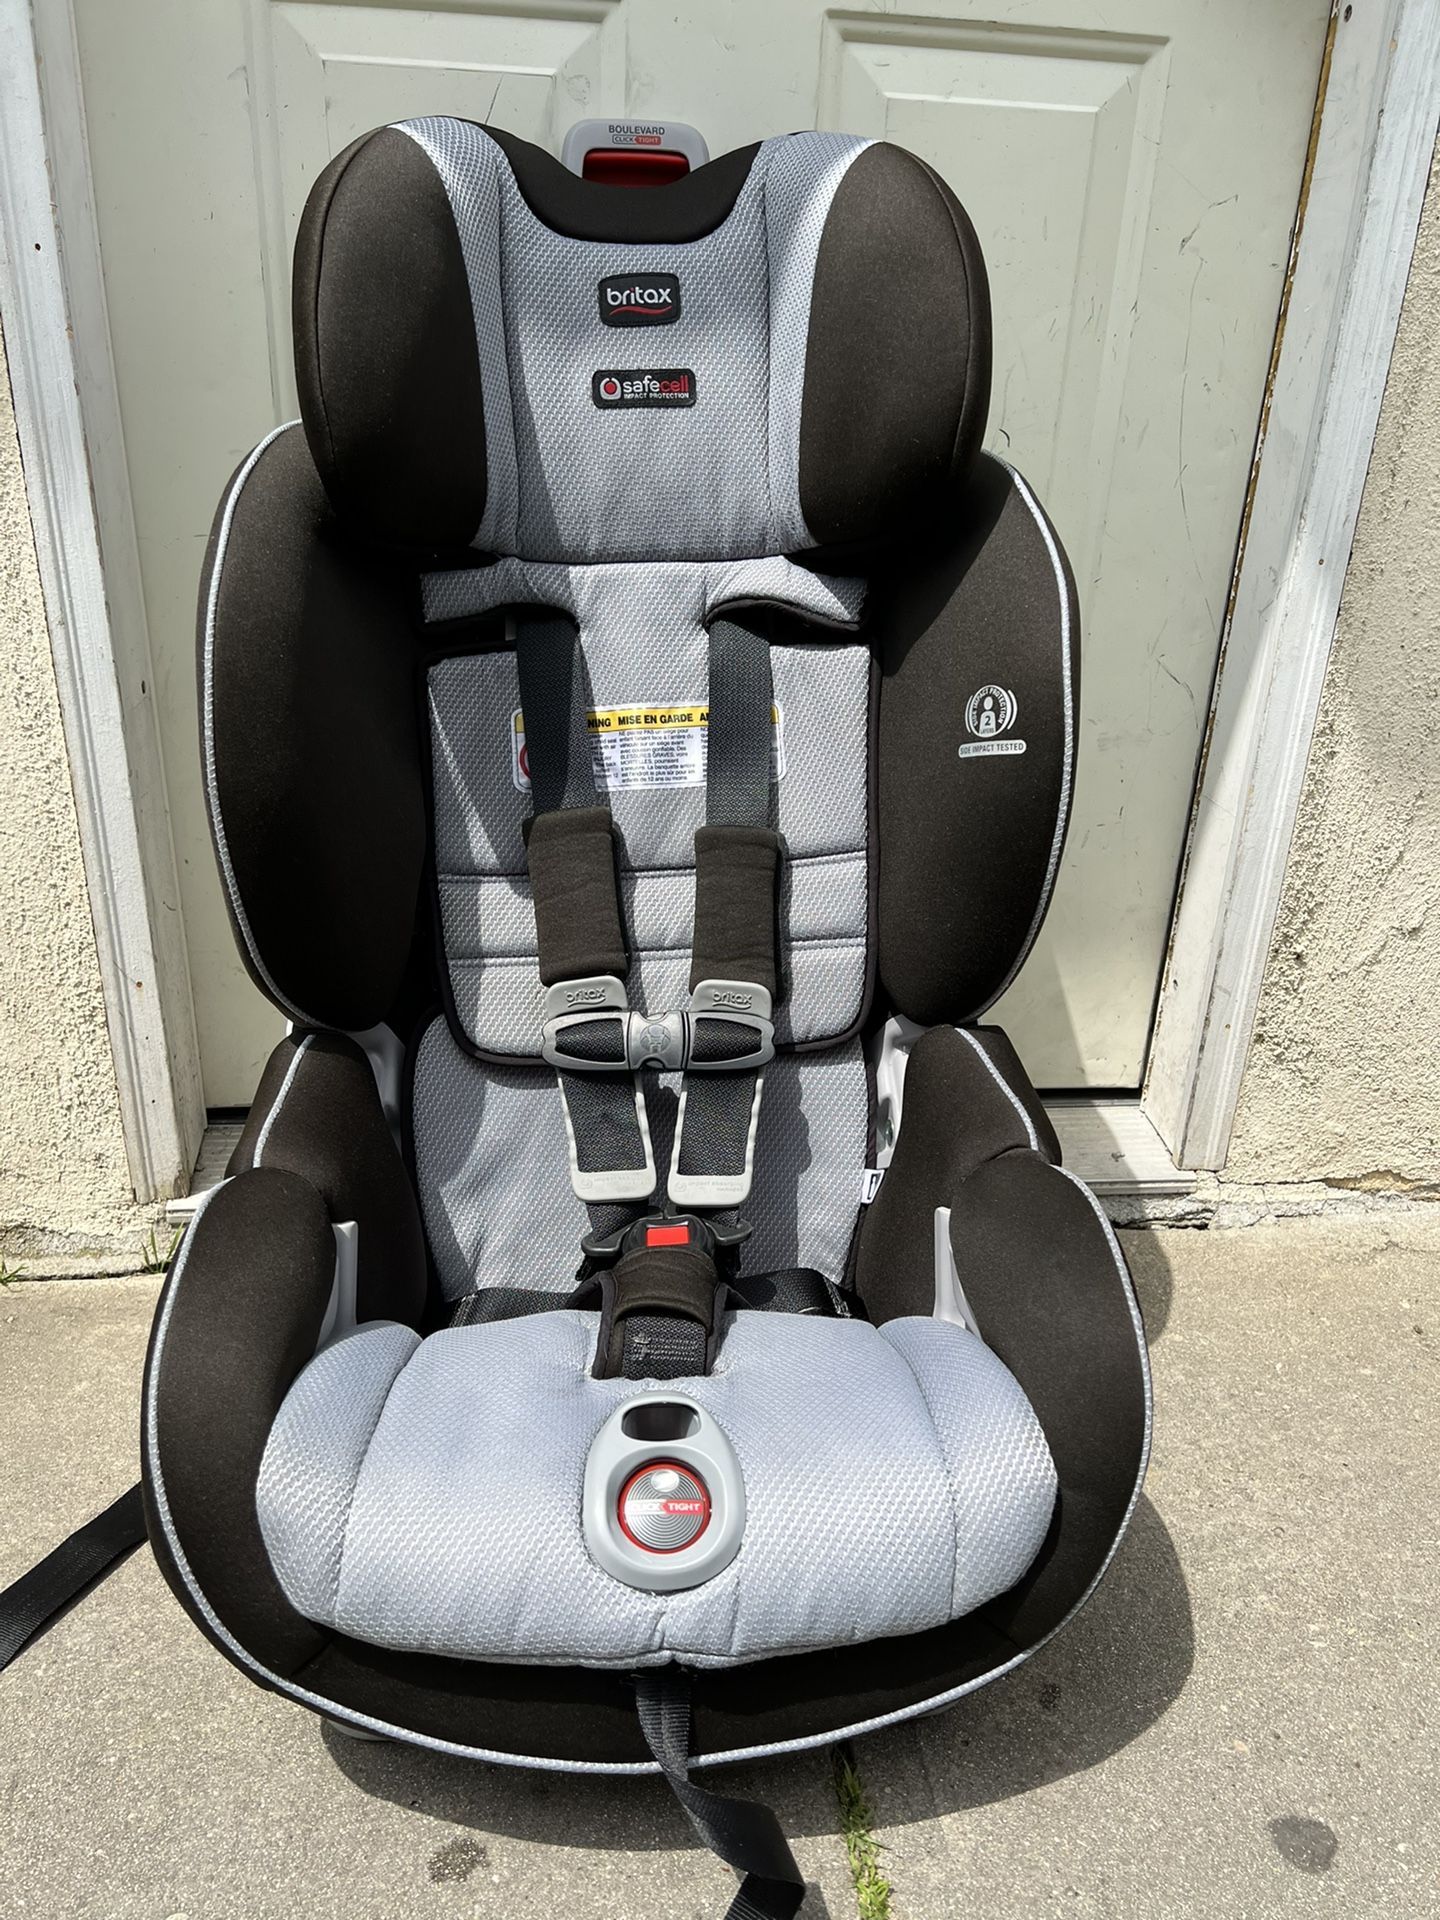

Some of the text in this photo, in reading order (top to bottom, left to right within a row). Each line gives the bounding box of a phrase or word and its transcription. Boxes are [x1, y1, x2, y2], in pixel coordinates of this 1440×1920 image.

[608, 124, 665, 135] BOULEVARD
[606, 286, 672, 306] britax
[622, 374, 689, 393] safecell
[989, 688, 1006, 724] PROTECTION
[618, 715, 641, 726] MISE
[644, 715, 657, 724] EN
[660, 713, 693, 723] GARDE
[985, 716, 991, 725] 2
[973, 744, 994, 753] IMPACT
[667, 1503, 701, 1511] TIGHT
